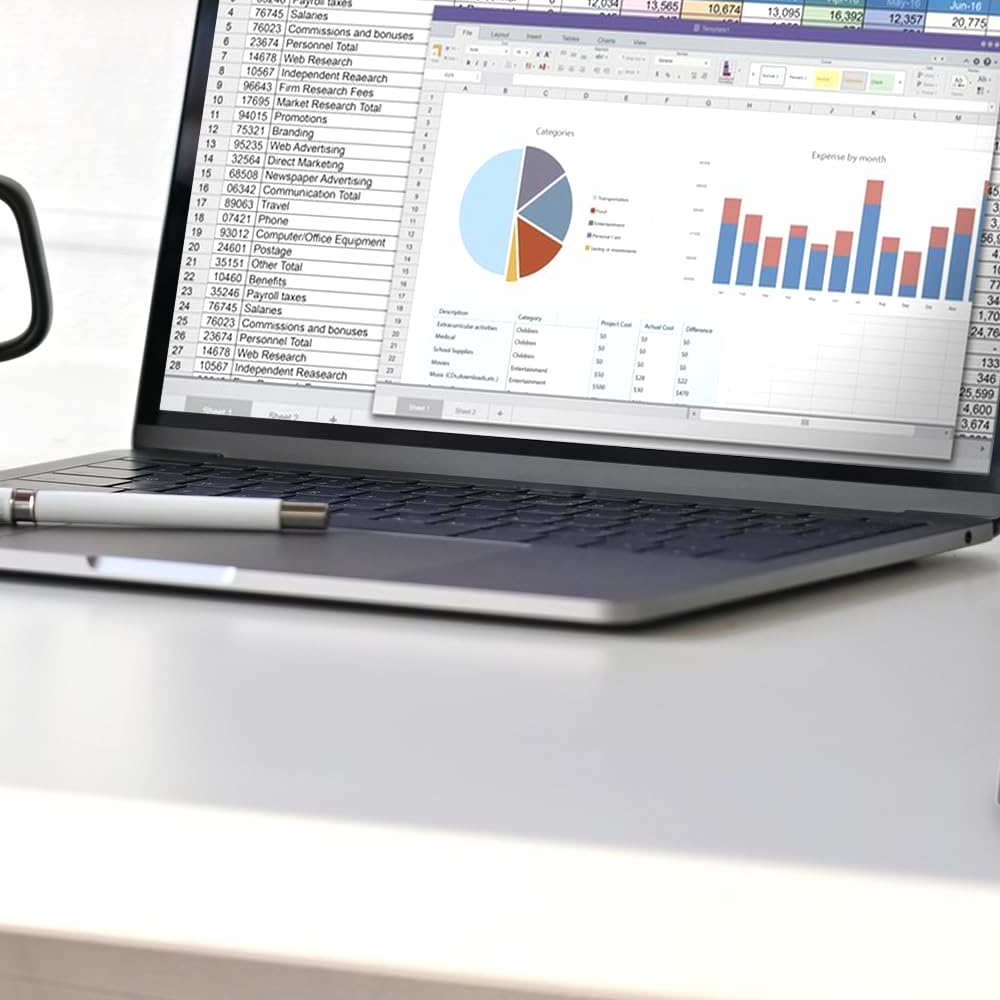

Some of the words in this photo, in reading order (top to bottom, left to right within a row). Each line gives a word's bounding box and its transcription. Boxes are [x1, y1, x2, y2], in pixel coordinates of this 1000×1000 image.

[328, 0, 352, 7] taxes
[646, 1, 678, 12] 13,565
[950, 1, 981, 11] Jun-16
[255, 8, 283, 18] 76745
[708, 3, 740, 16] 10,674
[768, 7, 800, 20] 13,095
[291, 10, 328, 21] Salaries
[830, 10, 863, 22] 16,392
[890, 13, 923, 25] 12,357
[253, 23, 281, 33] 76023
[952, 17, 987, 28] 20,775
[288, 25, 350, 37] Commissions
[354, 29, 371, 38] and
[374, 29, 414, 40] bonuses
[250, 38, 278, 47] 23674
[286, 39, 333, 50] Personnel
[337, 41, 358, 51] Total
[249, 53, 277, 62] 14678
[284, 54, 305, 63] Web
[308, 55, 352, 66] Research
[246, 67, 274, 76] 10567
[281, 68, 339, 81] Independent
[243, 81, 272, 92] 96643
[279, 83, 299, 93] Firm
[303, 84, 347, 95] Research
[350, 87, 374, 97] Fees
[242, 96, 270, 106] 17695
[277, 98, 308, 109] Market
[312, 100, 356, 111] Research
[360, 102, 381, 113] Total
[239, 110, 267, 120] 94015
[274, 112, 327, 124] Promotions
[236, 125, 264, 135] 75321
[272, 127, 314, 139] Branding
[536, 127, 574, 137] Categories
[234, 140, 263, 150] 95235
[270, 142, 291, 151] Web
[293, 143, 345, 158] Advertising
[231, 154, 260, 164] 32564
[812, 151, 844, 163] Expense
[847, 153, 857, 164] by
[860, 154, 886, 163] month
[267, 156, 295, 166] Direct
[298, 158, 344, 172] Marketing
[229, 169, 258, 180] 68508
[265, 171, 318, 184] Newspaper
[320, 174, 372, 188] Advertising
[227, 184, 256, 194] 06342
[263, 185, 335, 199] Communication
[339, 189, 360, 200] Total
[224, 198, 253, 209] 89063
[261, 200, 289, 210] Travel
[222, 213, 251, 223] 07421
[258, 215, 288, 226] Phone
[220, 228, 249, 239] 93012
[256, 229, 332, 244] Computer/Office
[335, 233, 386, 248] Equipment
[217, 243, 246, 253] 24601
[253, 244, 292, 256] Postage
[215, 257, 243, 268] 35151
[252, 259, 277, 270] Other
[281, 260, 302, 272] Total
[249, 275, 287, 286] Benefits
[246, 289, 278, 302] Payroll
[282, 293, 306, 302] taxes
[244, 304, 282, 315] Salaries
[518, 314, 542, 322] Category
[242, 319, 304, 332] Commissions
[307, 323, 325, 334] and
[328, 325, 368, 337] bonuses
[235, 364, 292, 377] Independent
